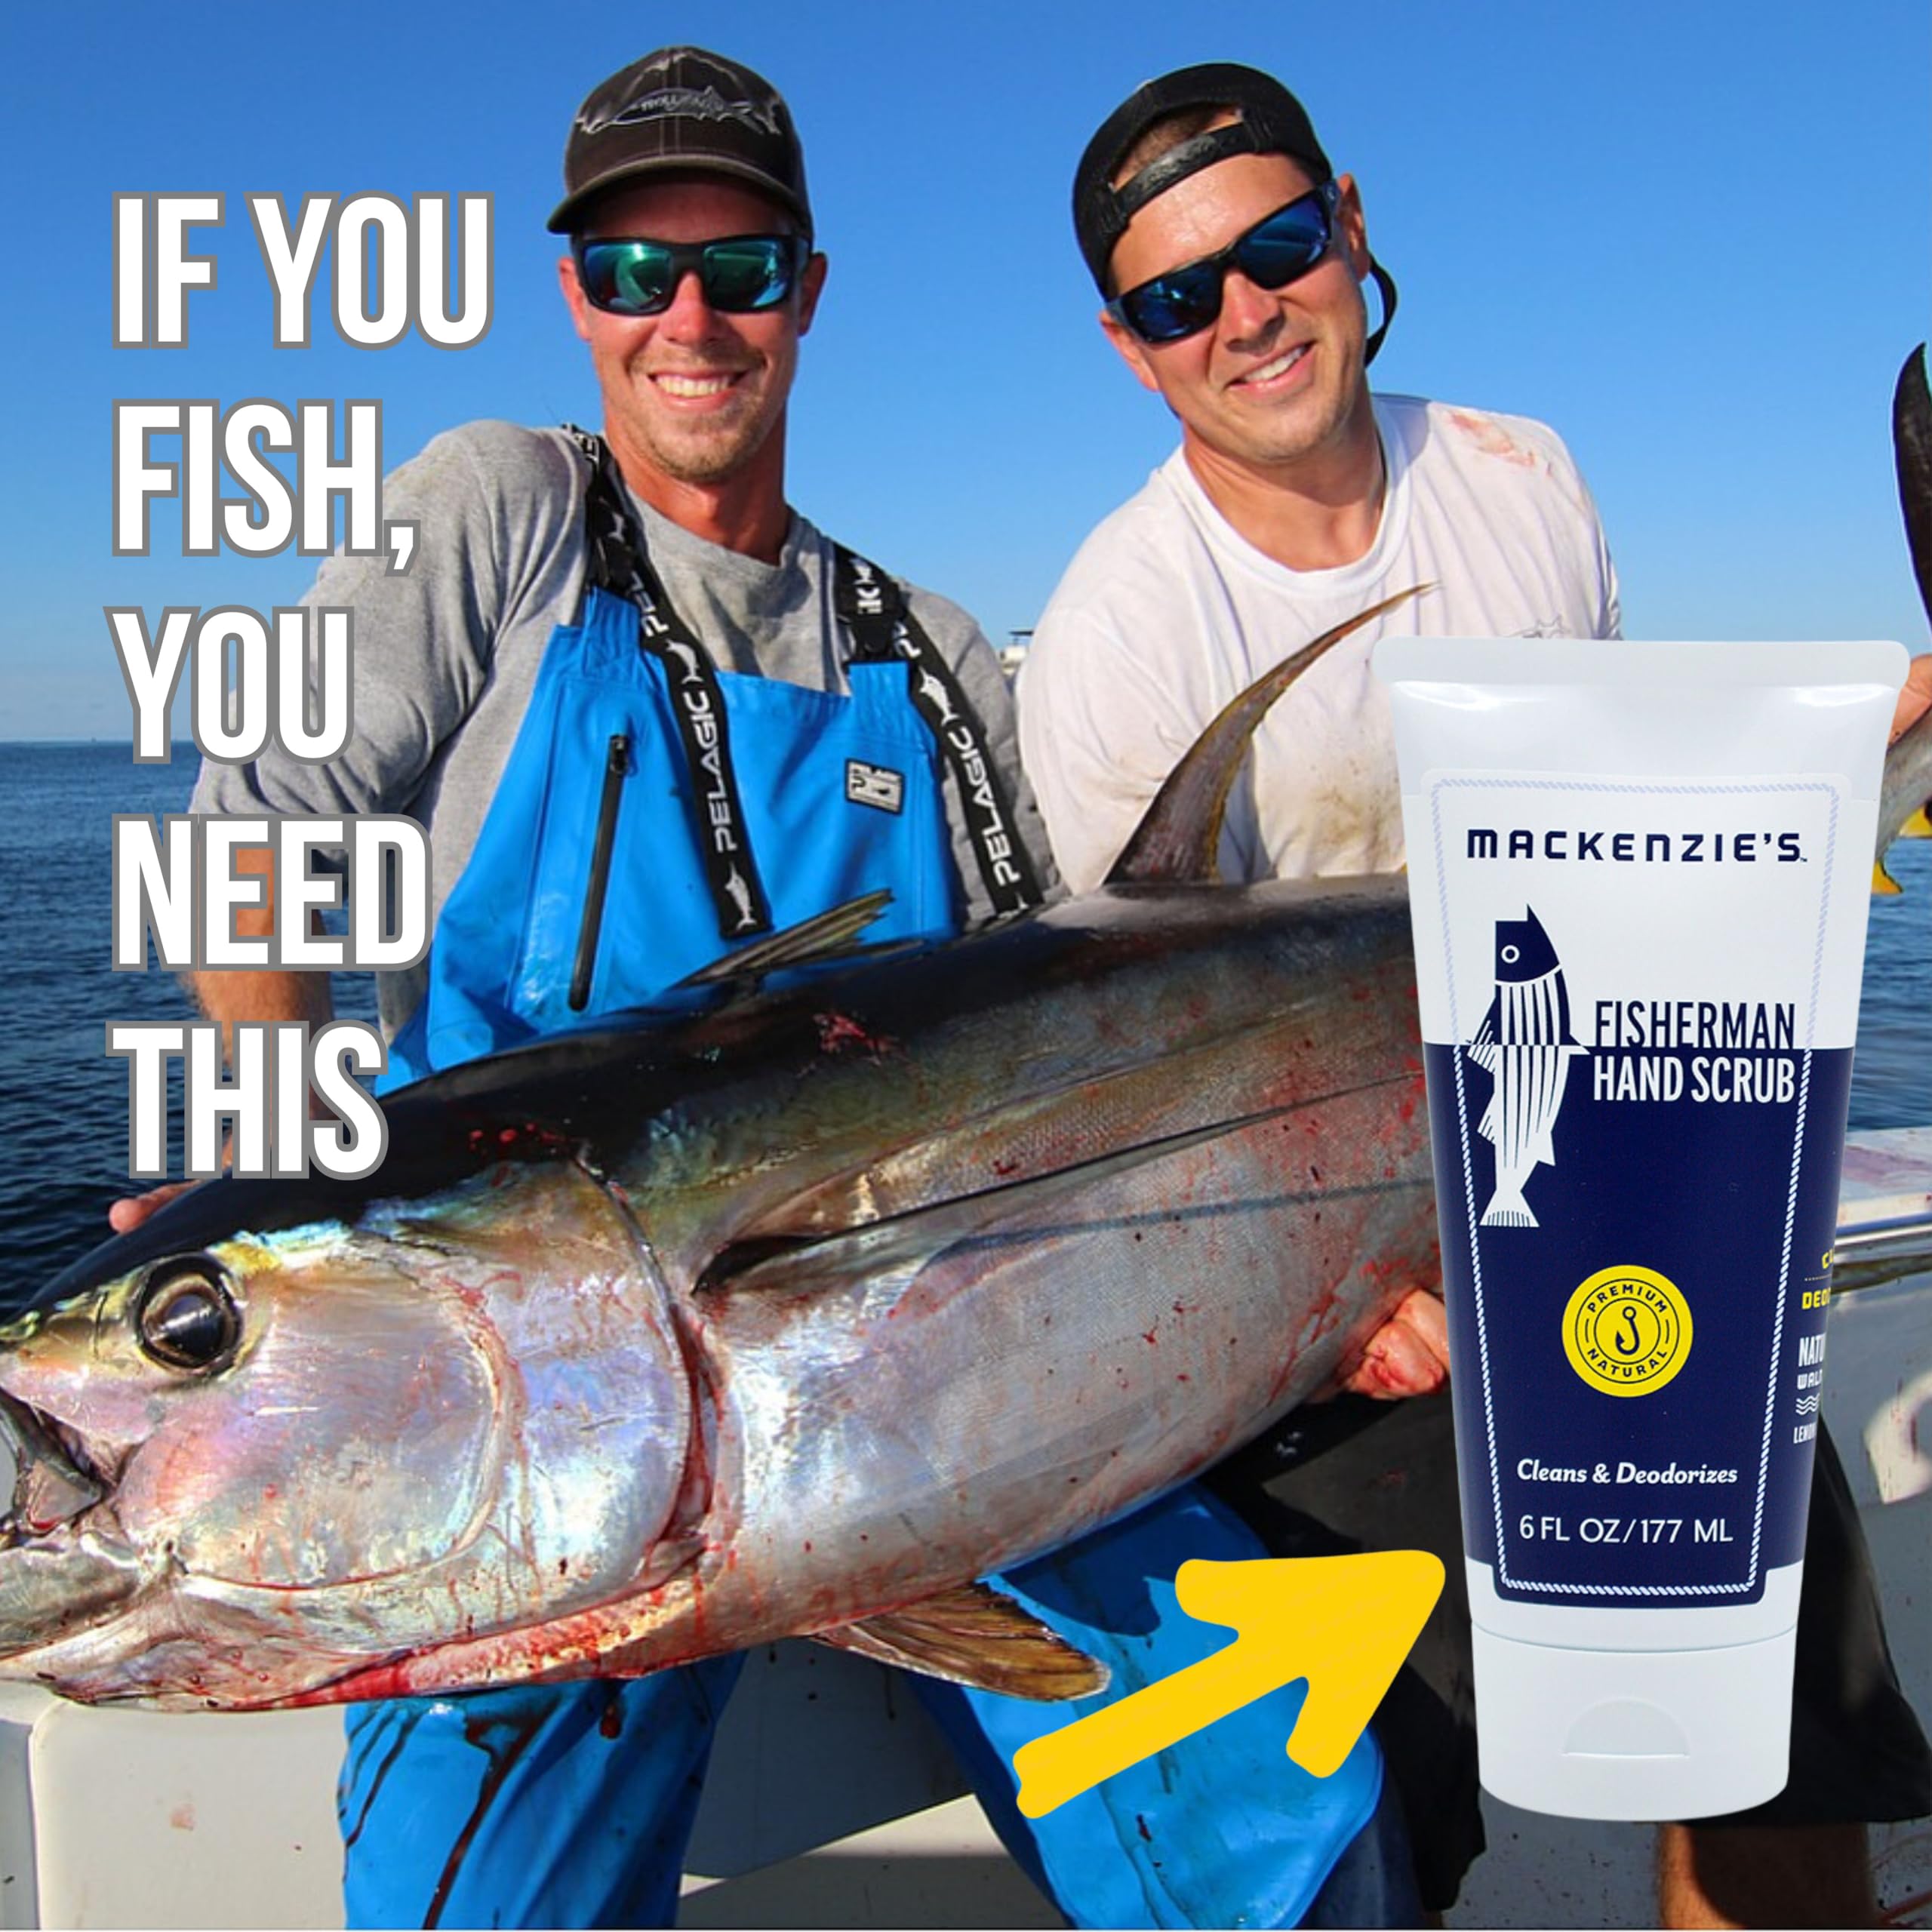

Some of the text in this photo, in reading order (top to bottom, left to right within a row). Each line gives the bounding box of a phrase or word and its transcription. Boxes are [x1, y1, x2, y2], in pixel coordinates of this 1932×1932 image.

[682, 690, 737, 853] PELAGIC
[947, 726, 1021, 886] PELAGIC
[1467, 829, 1801, 862] MACKENZIE'S
[1595, 1000, 1795, 1050] FISHERMAN
[1593, 1055, 1795, 1103] HAND SCRUB
[1588, 1284, 1667, 1312] PREMIUM
[1588, 1348, 1667, 1377] NATURAL
[1517, 1458, 1738, 1484] Cleans & Deodorizes
[1519, 1515, 1534, 1540] 6
[1540, 1517, 1571, 1541] FL
[1694, 1518, 1734, 1543] ML
